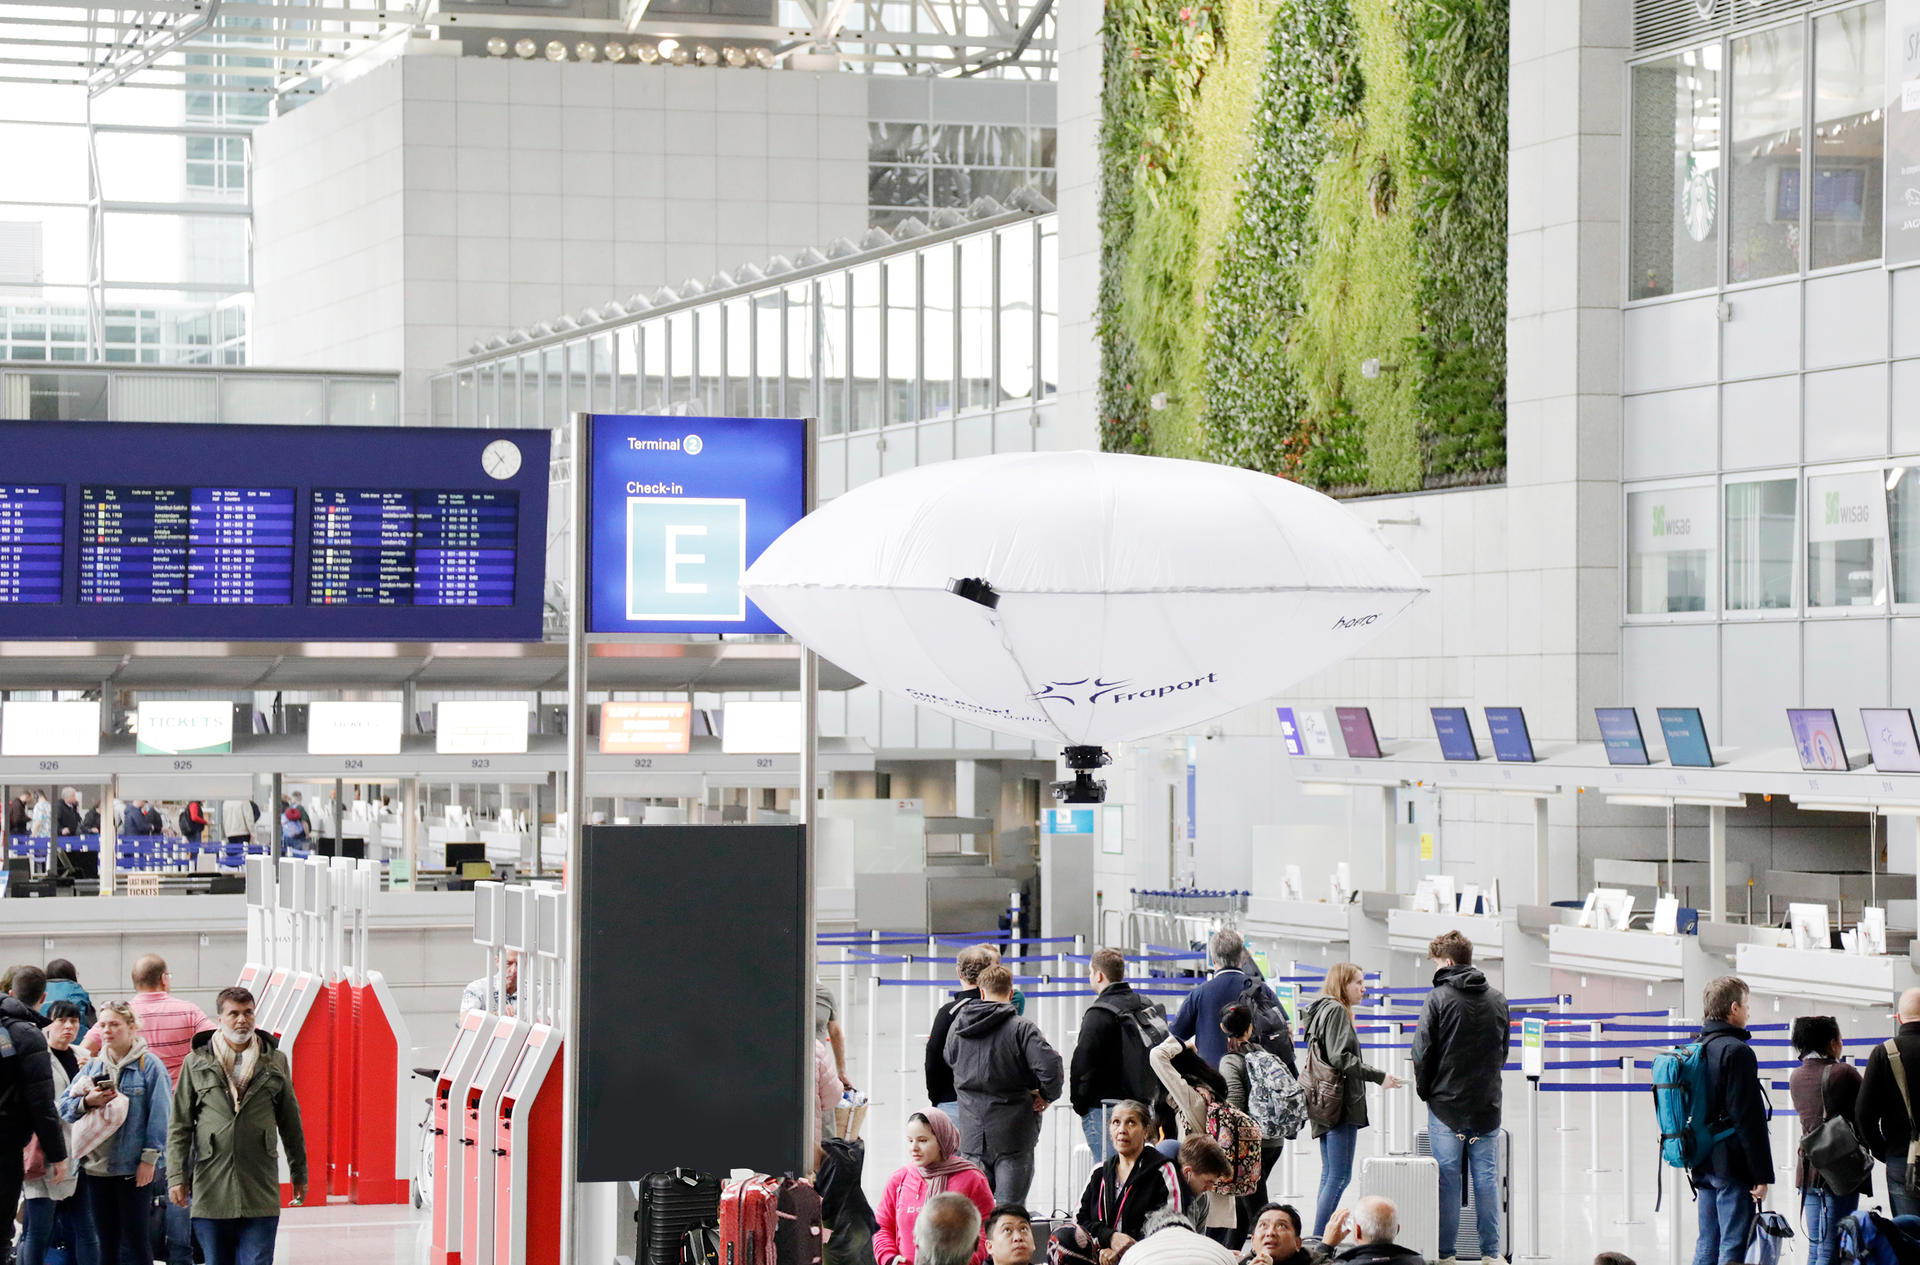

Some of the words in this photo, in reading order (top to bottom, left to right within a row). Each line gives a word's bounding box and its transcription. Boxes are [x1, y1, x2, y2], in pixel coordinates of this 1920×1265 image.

[627, 437, 681, 451] Terminal
[626, 482, 683, 495] Check-in
[665, 525, 708, 593] E
[1114, 673, 1217, 703] Fraport
[149, 717, 223, 728] TICKETS
[39, 761, 59, 770] 926
[173, 761, 192, 770] 925
[345, 759, 363, 768] 924
[471, 759, 490, 768] 923
[634, 759, 652, 768] 922
[756, 759, 772, 767] 921
